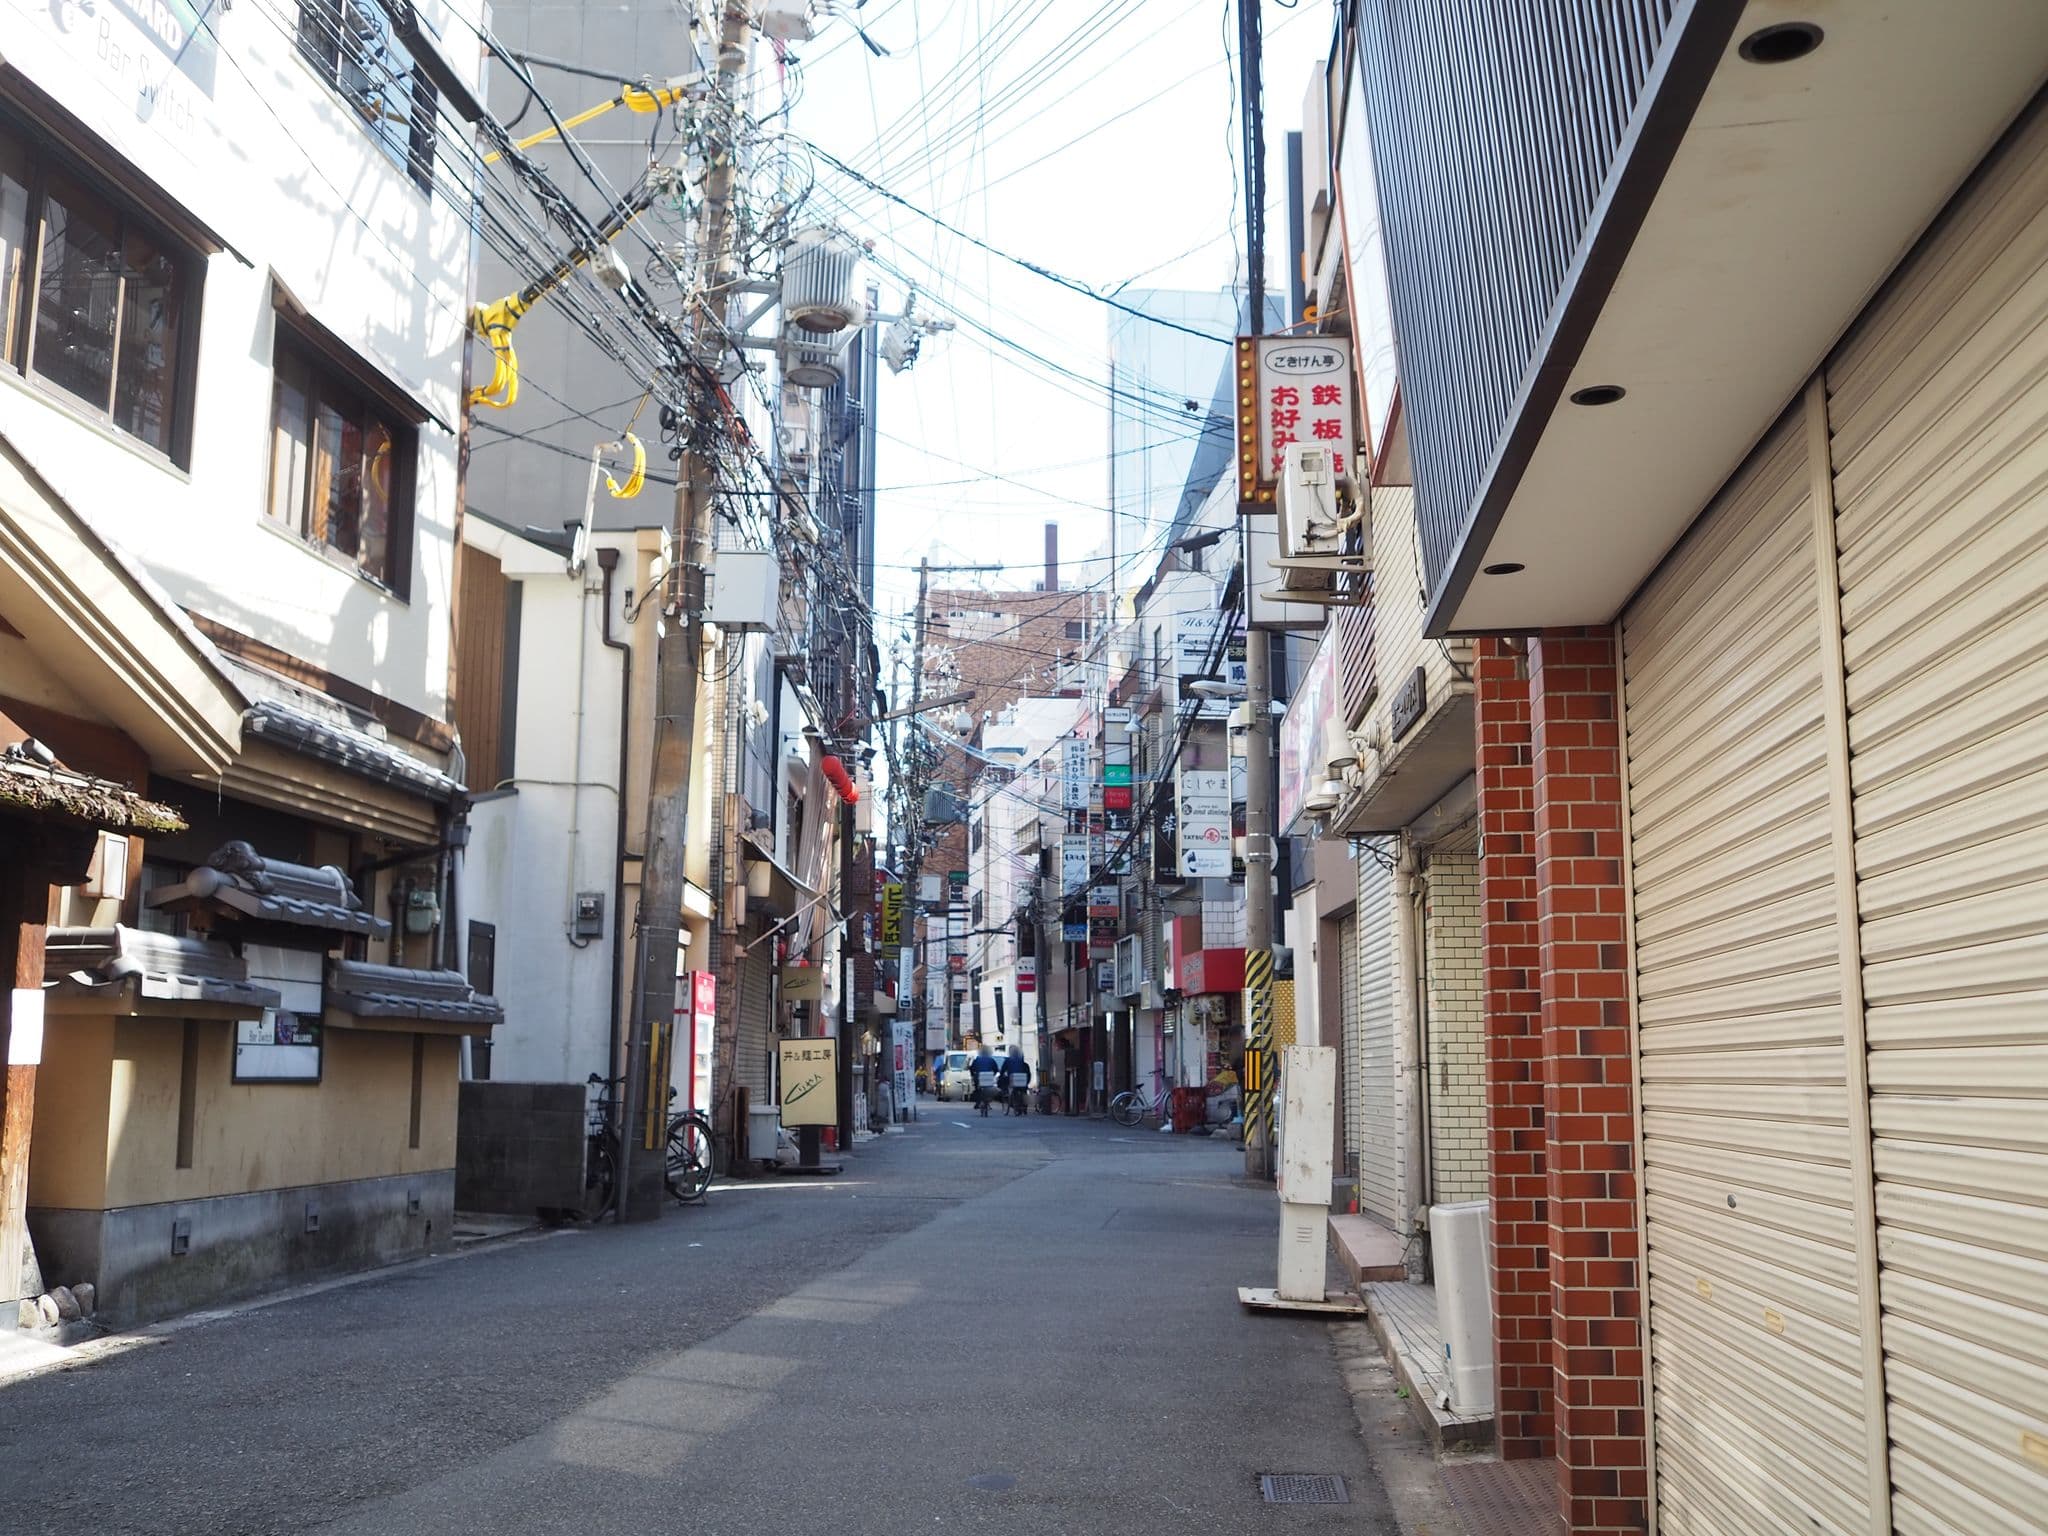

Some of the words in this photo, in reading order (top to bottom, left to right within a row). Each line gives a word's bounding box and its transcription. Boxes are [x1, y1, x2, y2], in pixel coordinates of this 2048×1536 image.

[97, 16, 131, 79] Bar
[138, 54, 195, 136] Switch
[1274, 356, 1335, 368] ごきげん亭
[1182, 777, 1228, 791] にしやま
